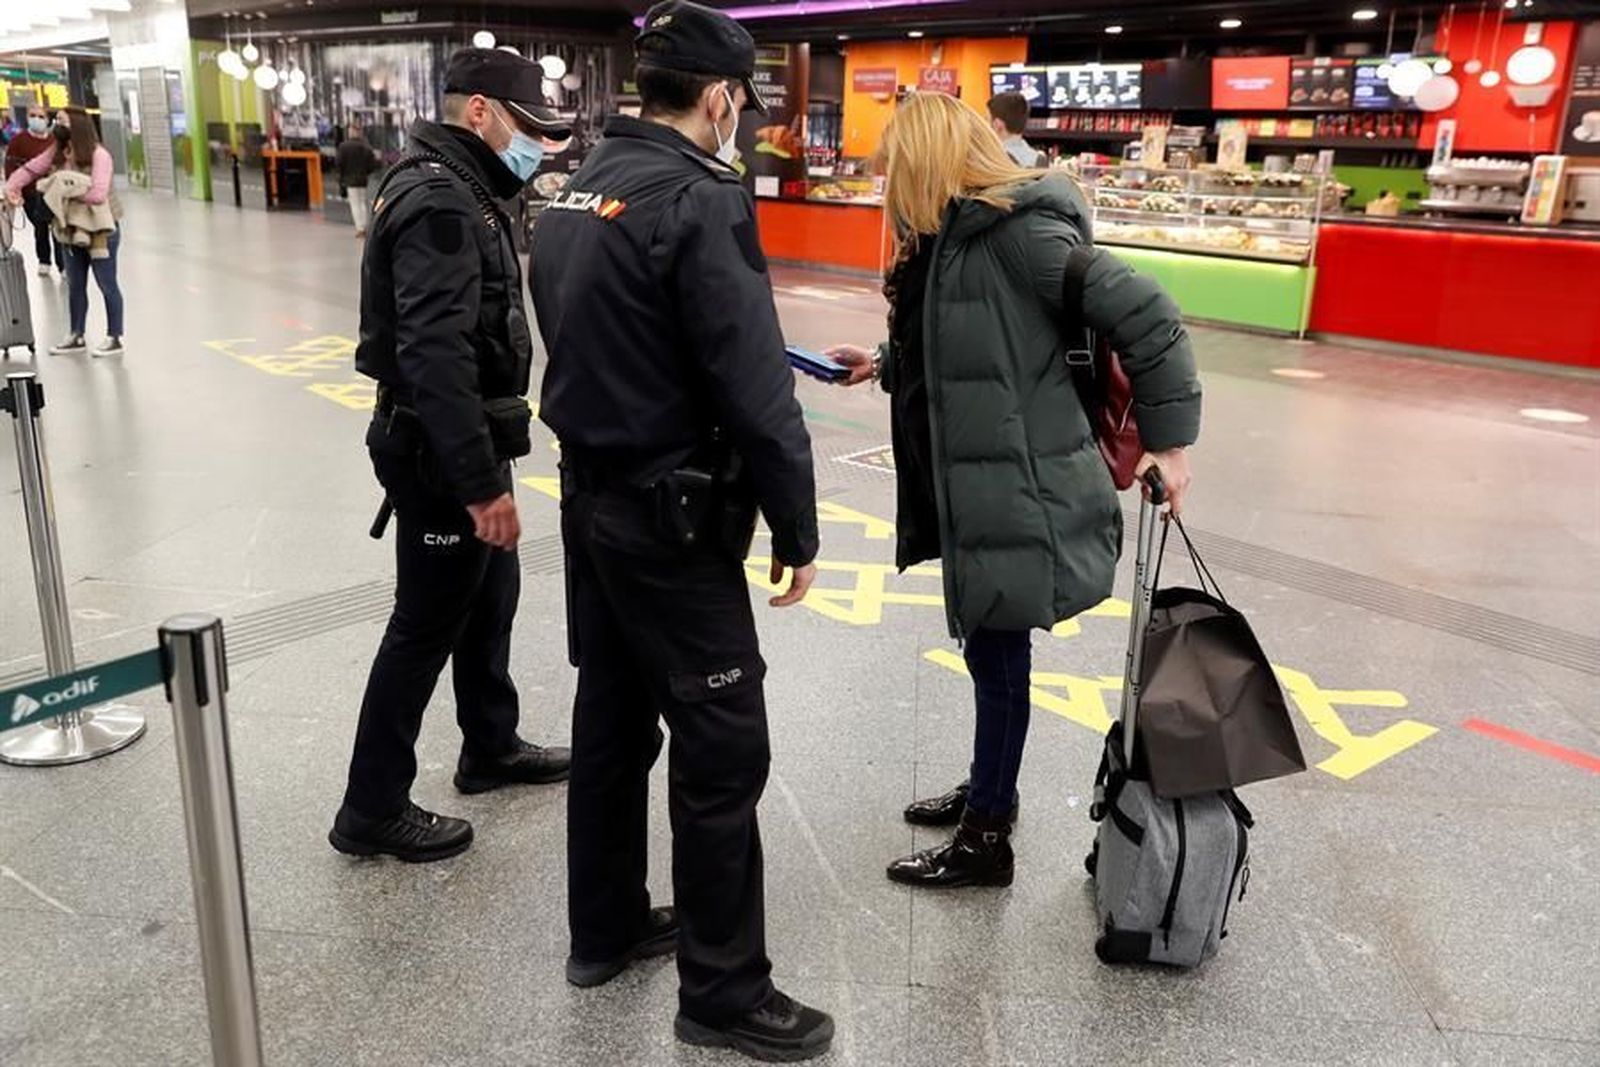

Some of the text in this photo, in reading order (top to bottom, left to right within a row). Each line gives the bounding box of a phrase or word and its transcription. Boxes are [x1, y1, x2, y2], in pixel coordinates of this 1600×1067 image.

[542, 191, 603, 212] LICIA
[423, 532, 461, 545] CNP
[708, 668, 743, 689] CNP
[42, 675, 100, 706] adif
